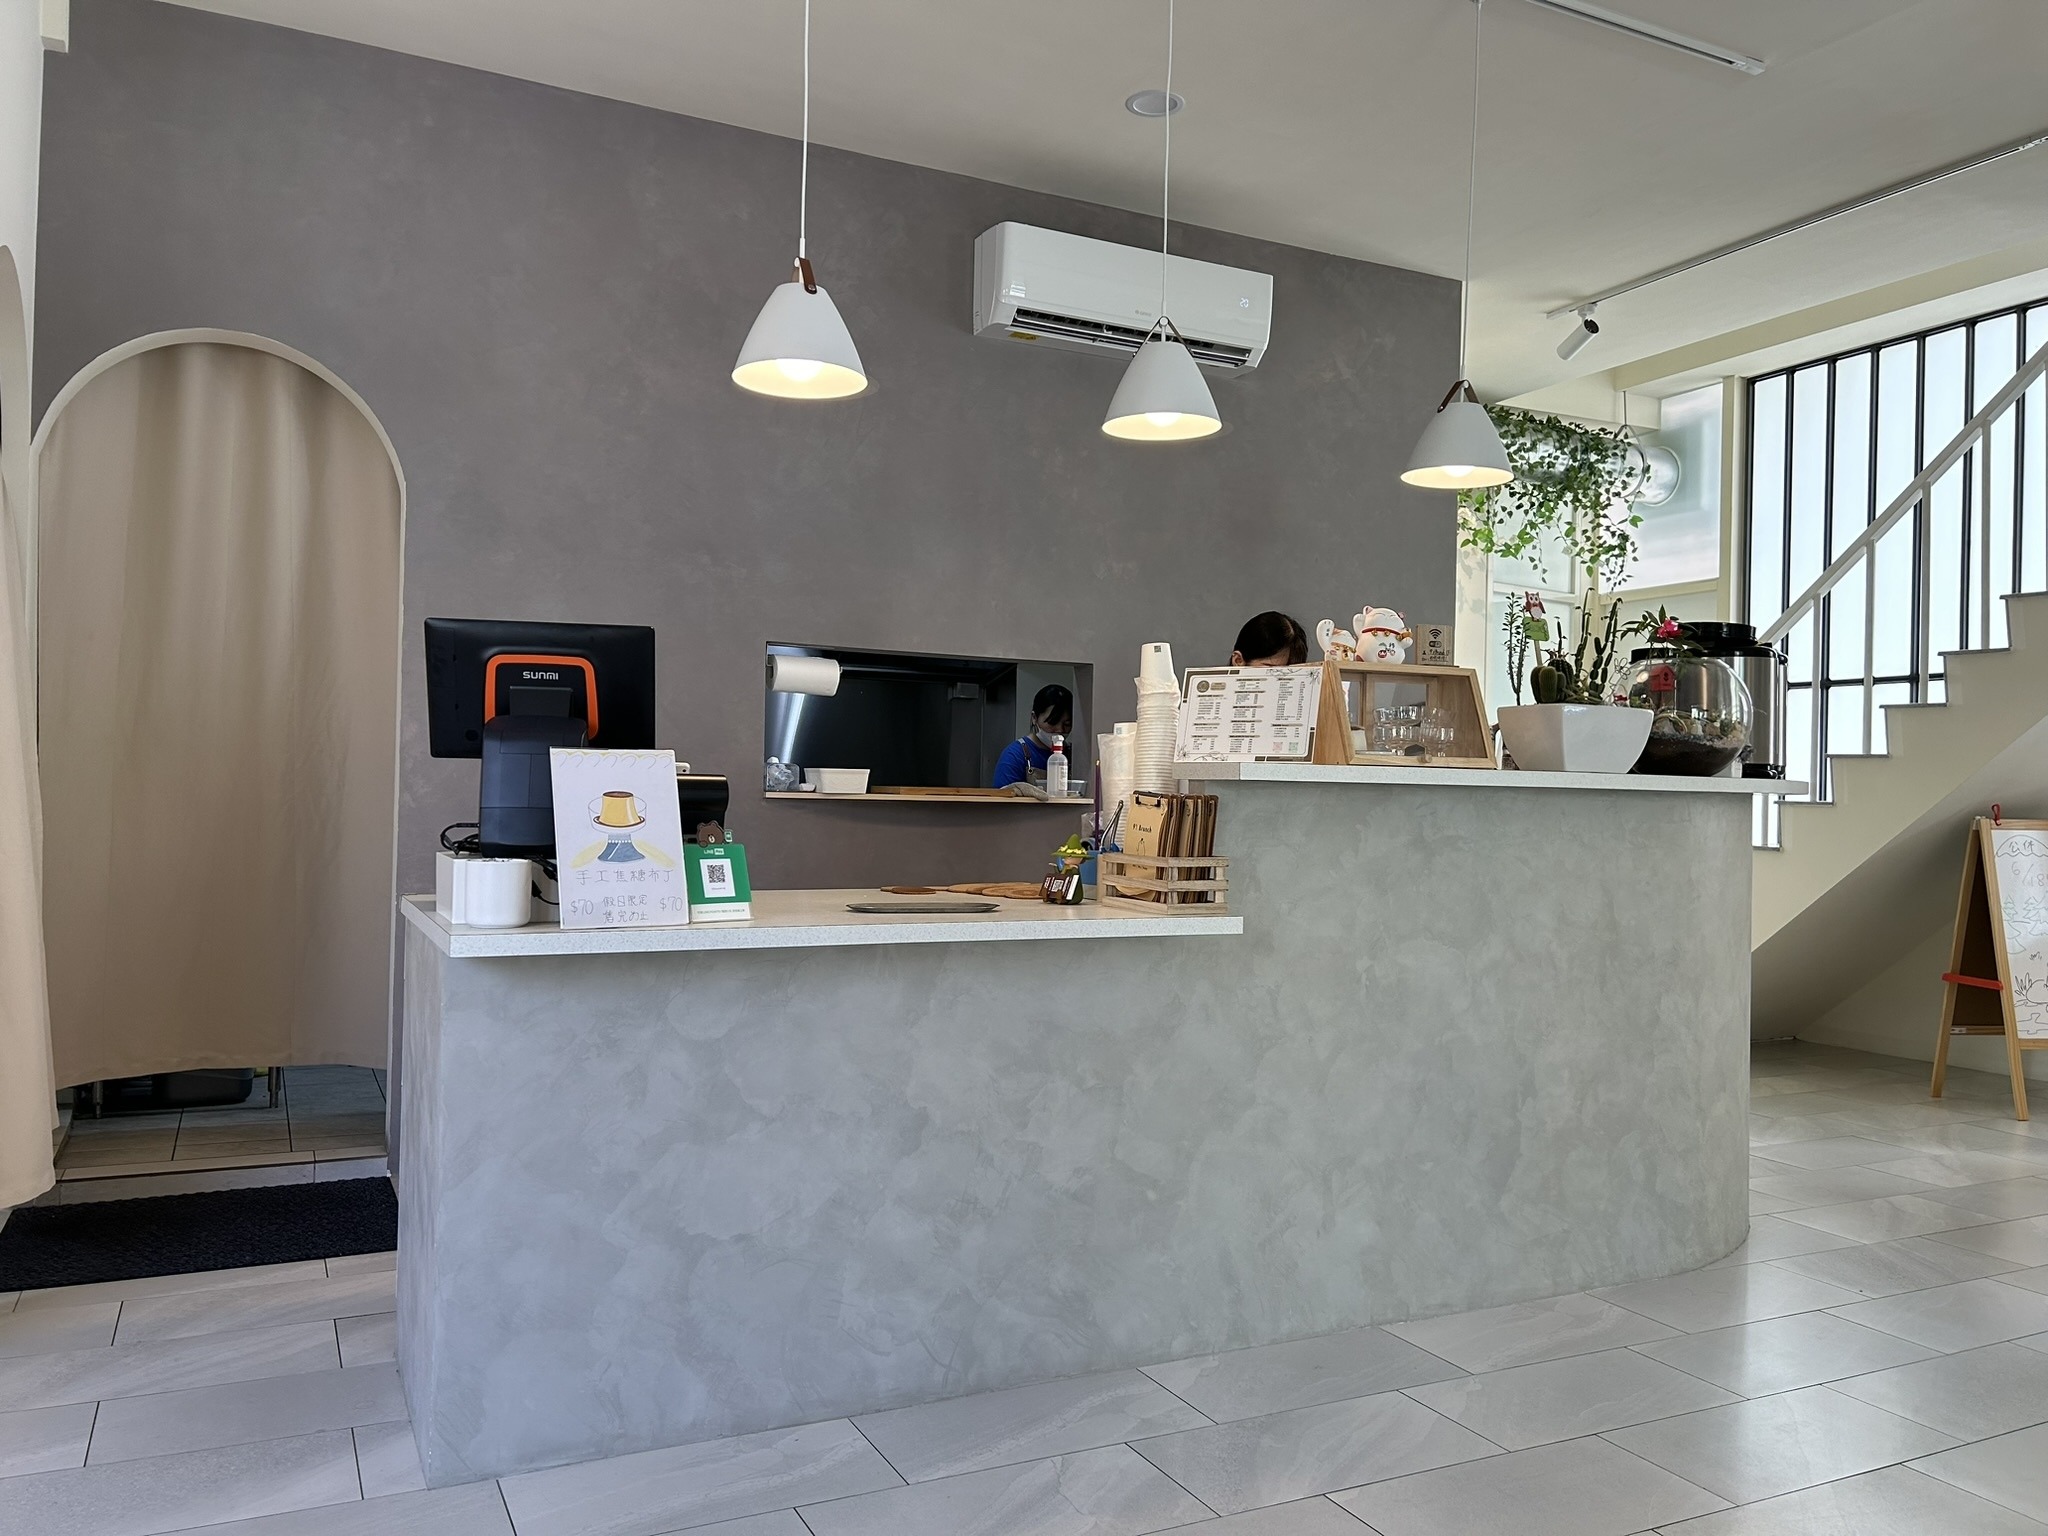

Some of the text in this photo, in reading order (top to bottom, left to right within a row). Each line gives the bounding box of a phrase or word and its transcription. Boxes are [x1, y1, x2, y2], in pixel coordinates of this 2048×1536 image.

[522, 671, 559, 680] SUNMI
[575, 868, 674, 886] 手工焦糖布丁
[570, 898, 594, 916] $70
[659, 896, 683, 911] $70
